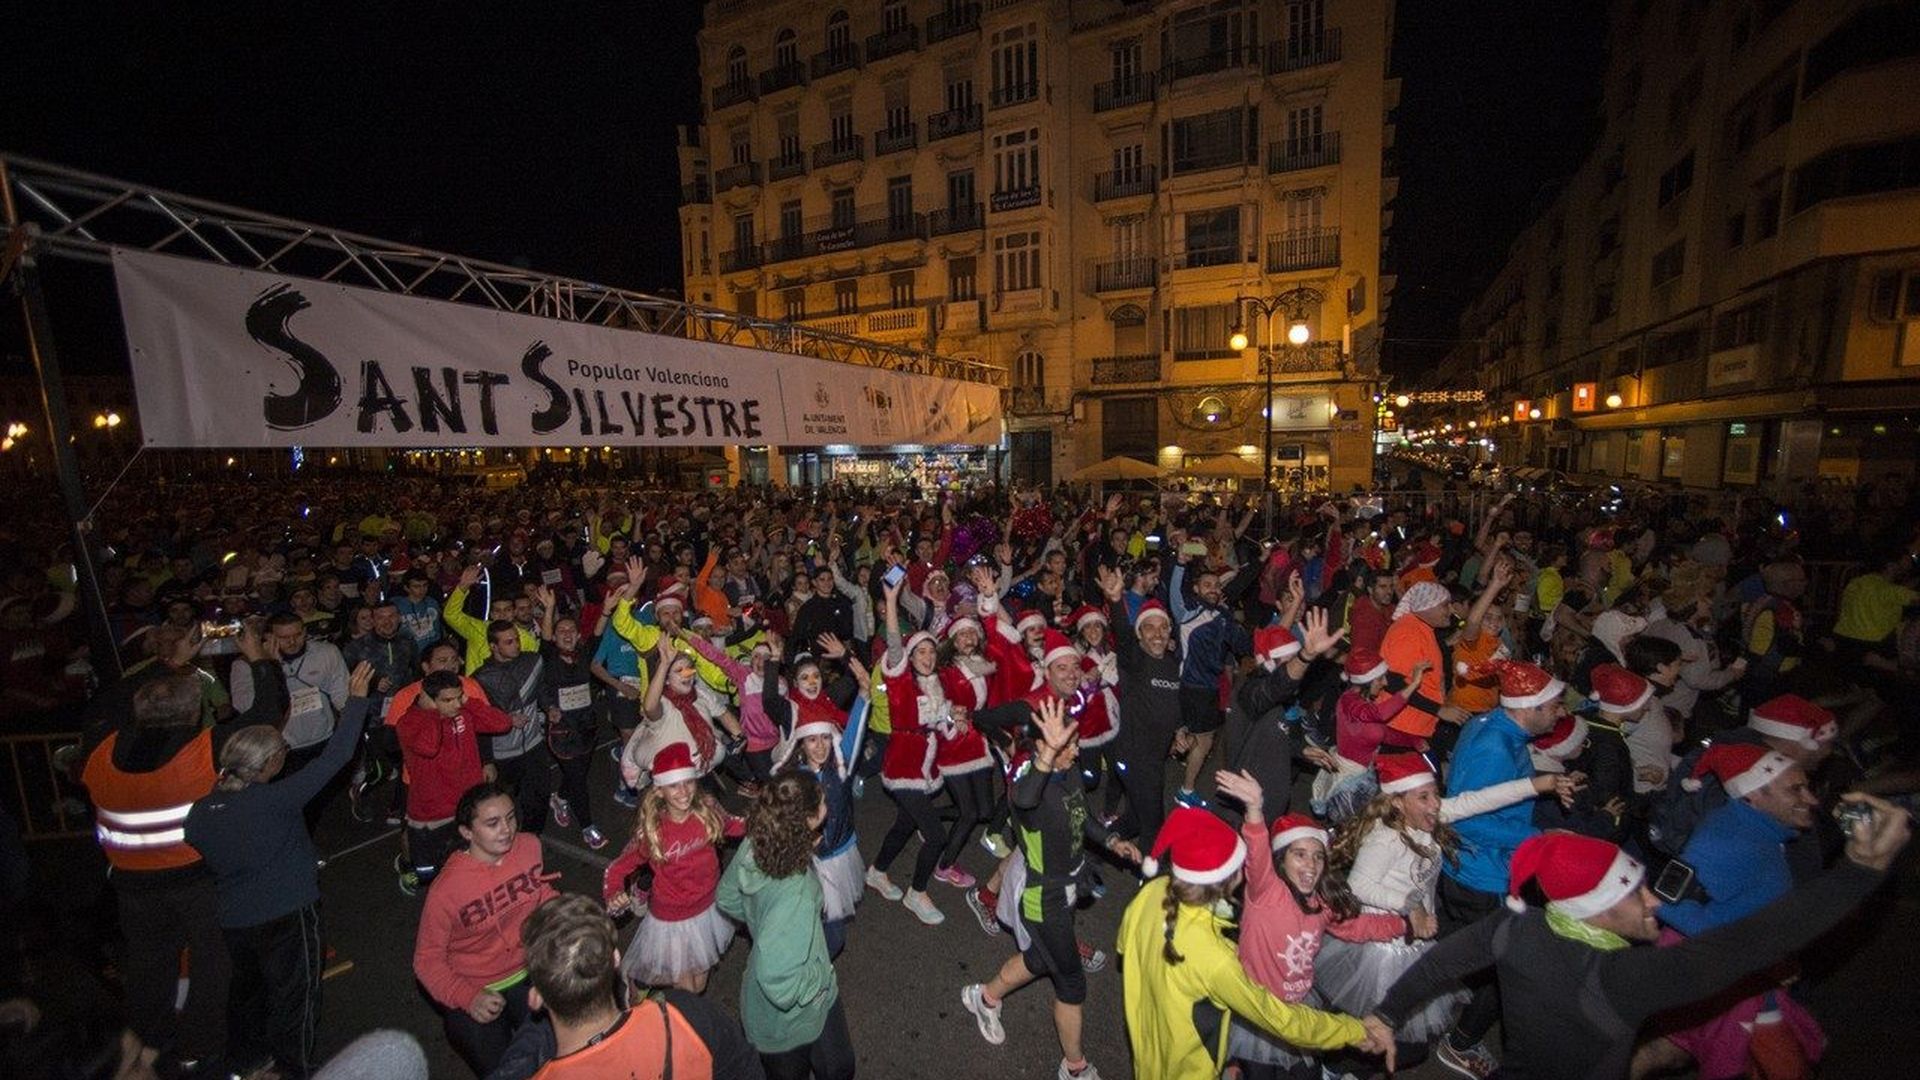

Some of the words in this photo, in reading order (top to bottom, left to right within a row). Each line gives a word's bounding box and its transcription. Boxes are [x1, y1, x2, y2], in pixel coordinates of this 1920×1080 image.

[245, 282, 511, 436] SANT
[521, 339, 763, 439] SILVESTRE
[568, 359, 641, 383] Popular
[645, 367, 729, 388] Valenciana
